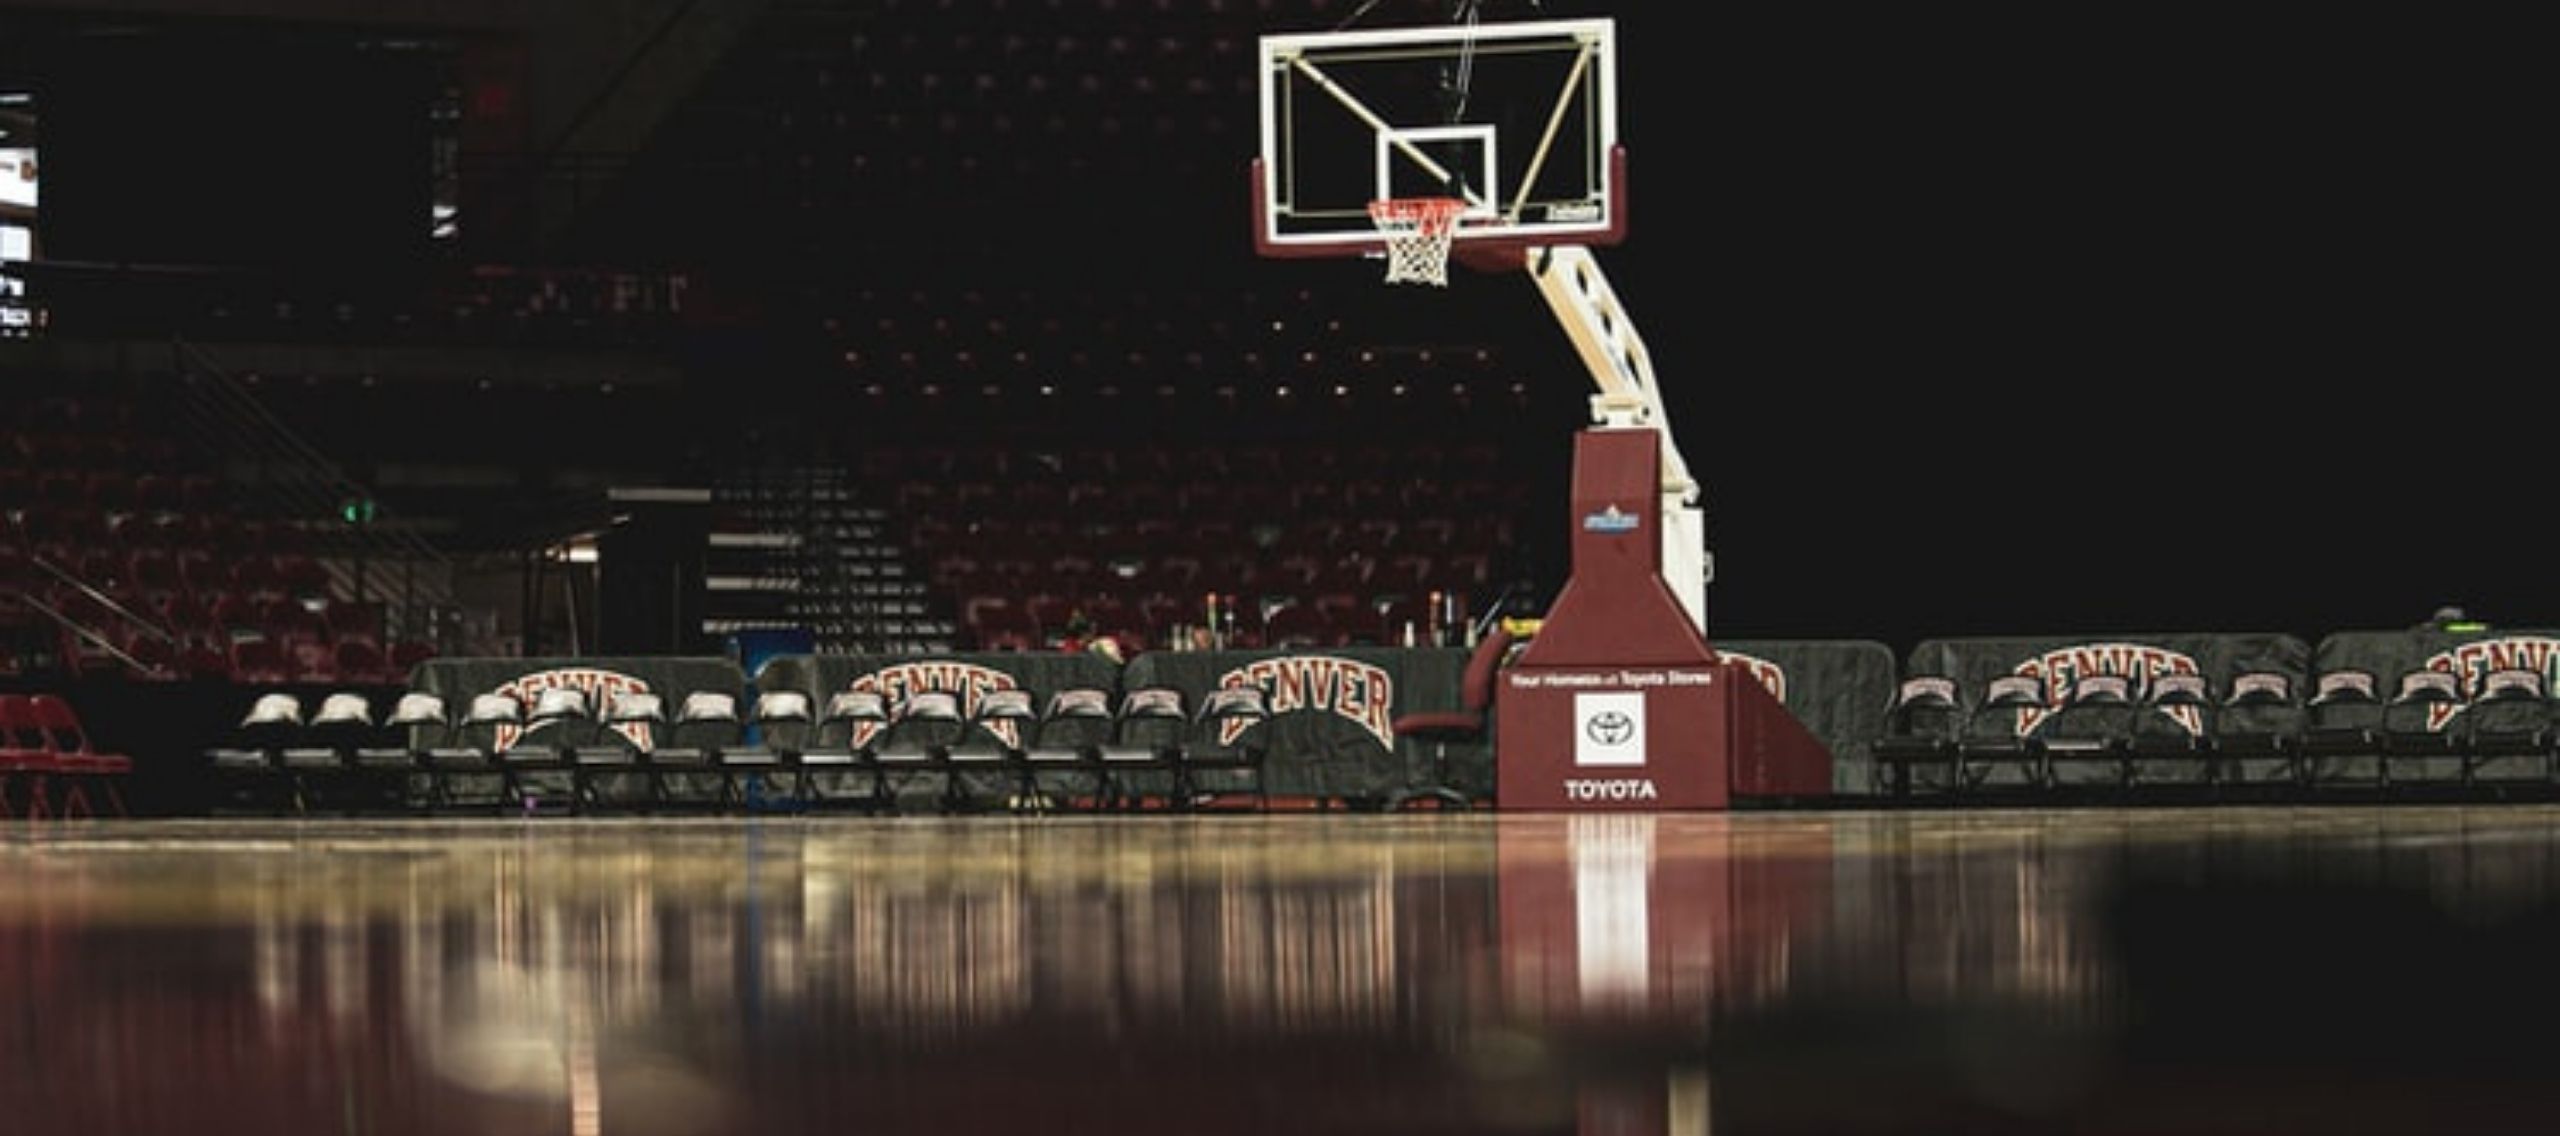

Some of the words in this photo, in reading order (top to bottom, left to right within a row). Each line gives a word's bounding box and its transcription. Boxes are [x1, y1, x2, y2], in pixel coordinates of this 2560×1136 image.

[1219, 656, 1393, 754] DENVER
[1619, 670, 1665, 688] Toyota
[2426, 636, 2560, 732] DENV
[1563, 779, 1658, 799] TOYOTA
